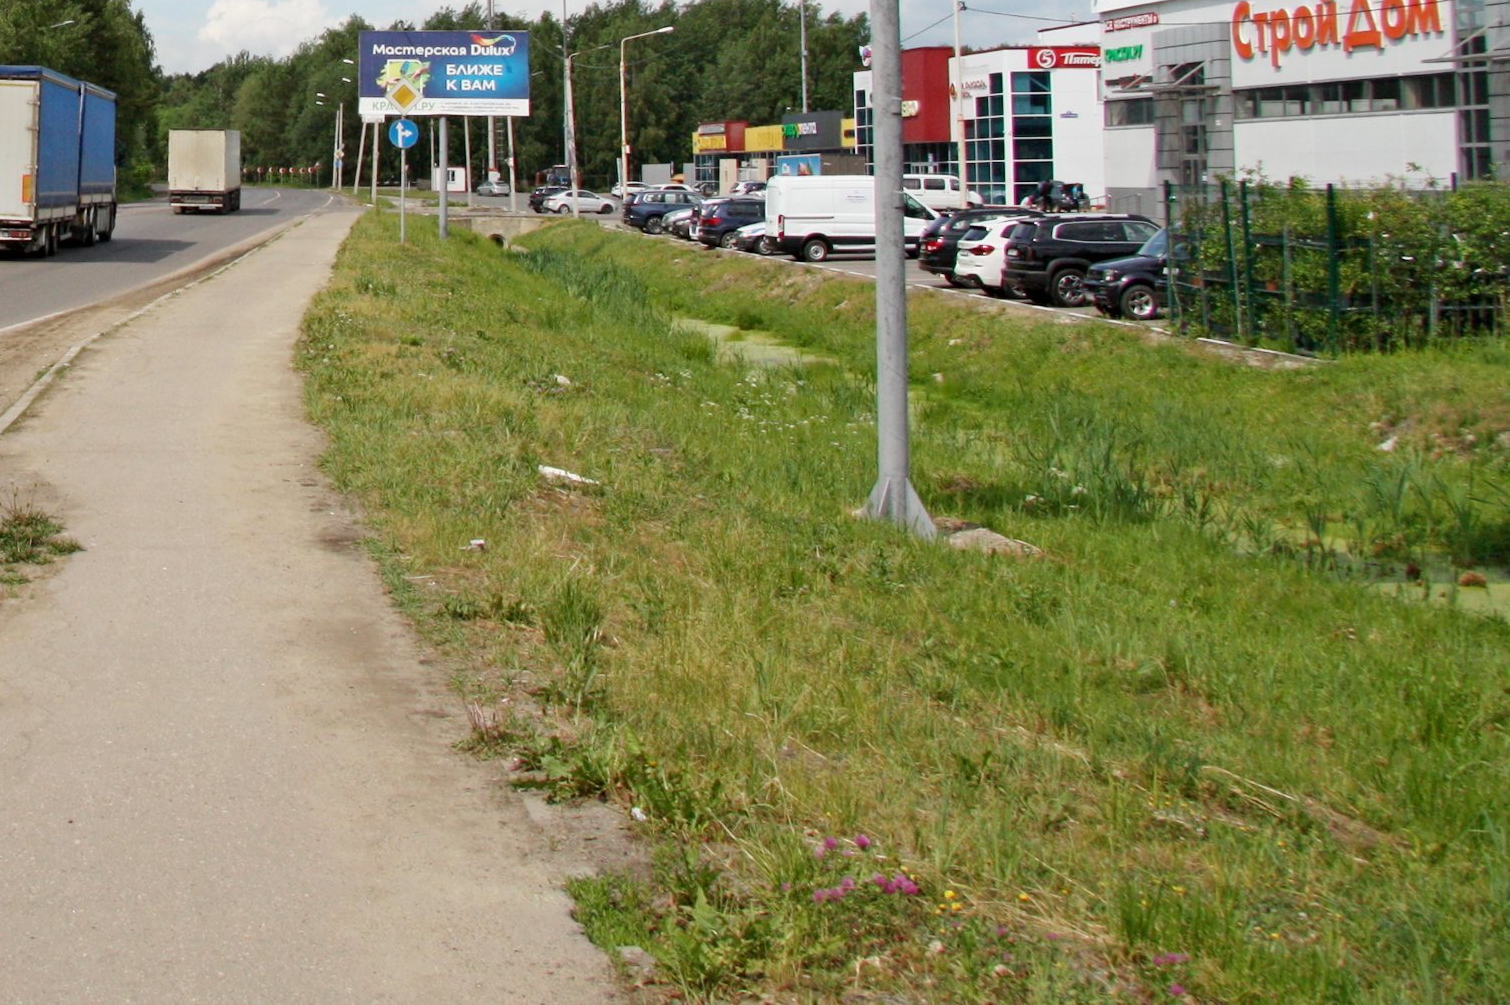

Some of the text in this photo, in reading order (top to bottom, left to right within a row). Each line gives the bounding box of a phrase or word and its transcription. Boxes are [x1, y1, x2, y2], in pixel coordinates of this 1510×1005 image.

[372, 44, 510, 58] Мастерская Dulux
[446, 64, 503, 76] БЛИЖЕ
[446, 79, 496, 91] К ВАМ
